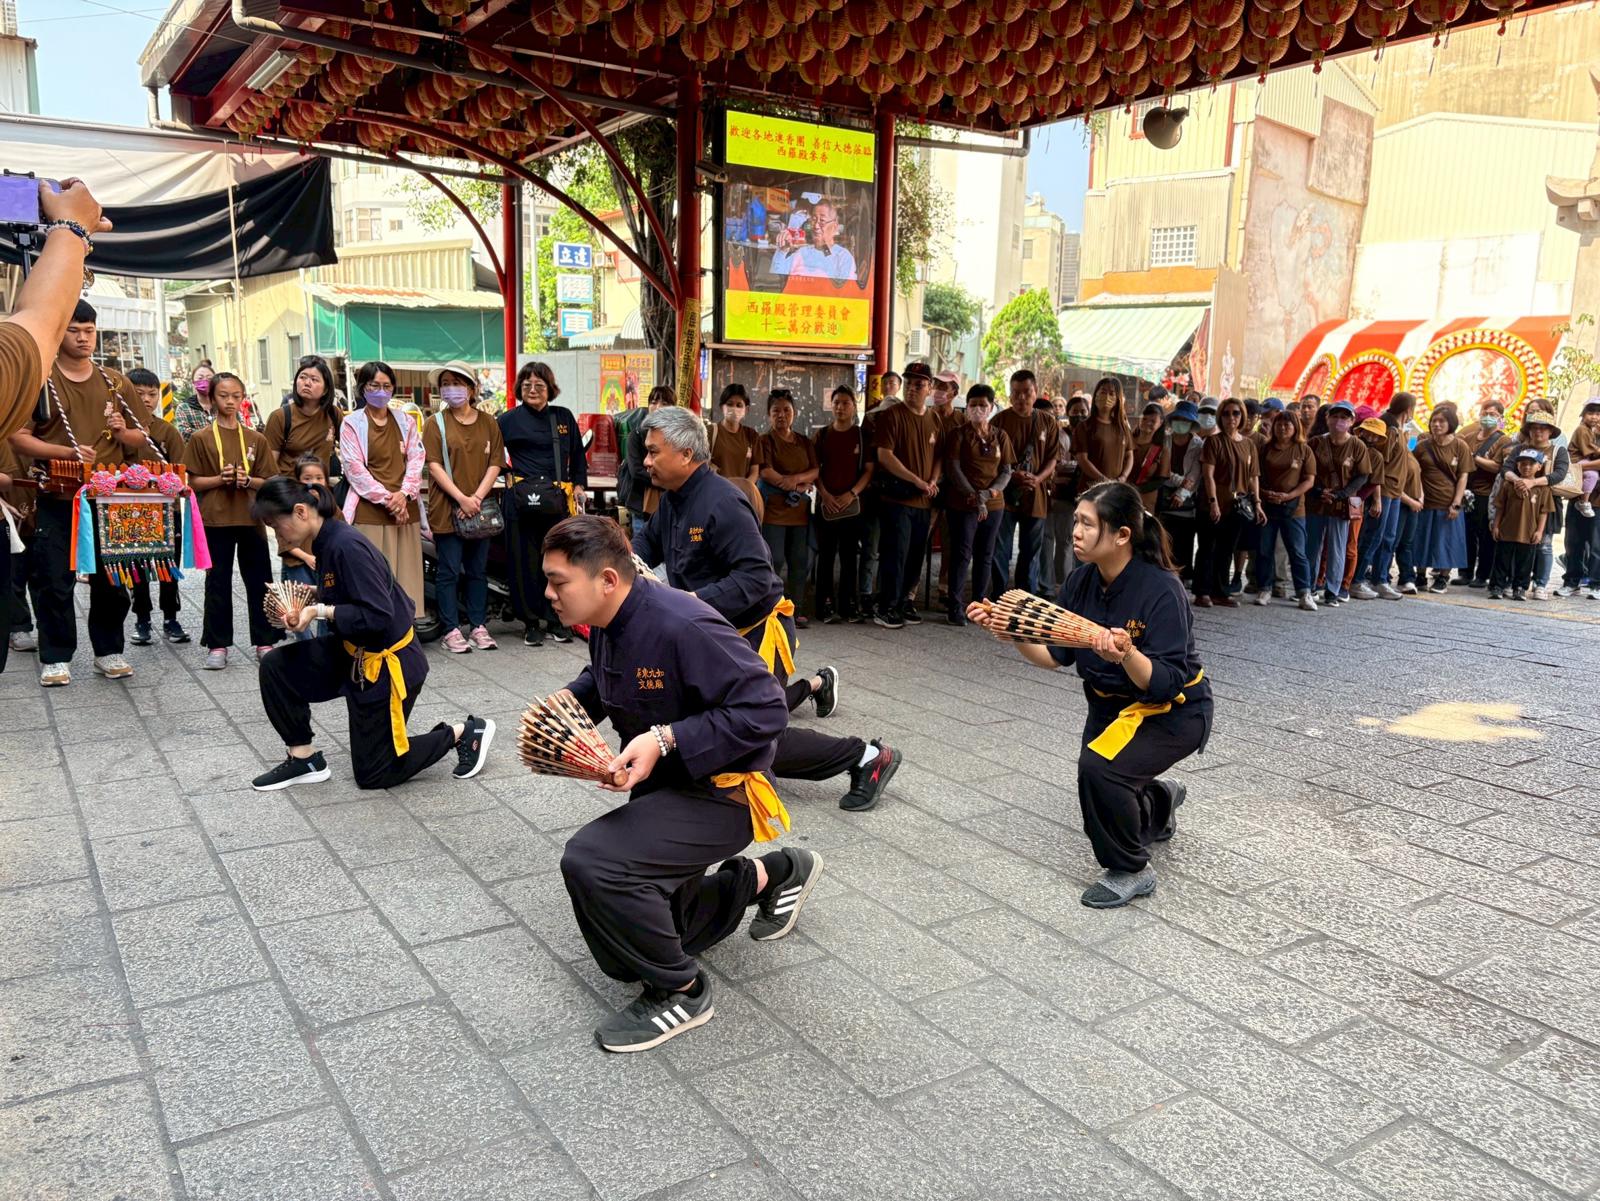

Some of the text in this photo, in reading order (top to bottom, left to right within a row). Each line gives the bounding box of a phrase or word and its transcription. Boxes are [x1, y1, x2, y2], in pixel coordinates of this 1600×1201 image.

[729, 124, 805, 147] 歡迎各地進香團
[777, 146, 828, 164] 西羅殿參香
[748, 301, 851, 321] 西羅殿管理委員會
[761, 318, 839, 336] 十二萬分歡迎
